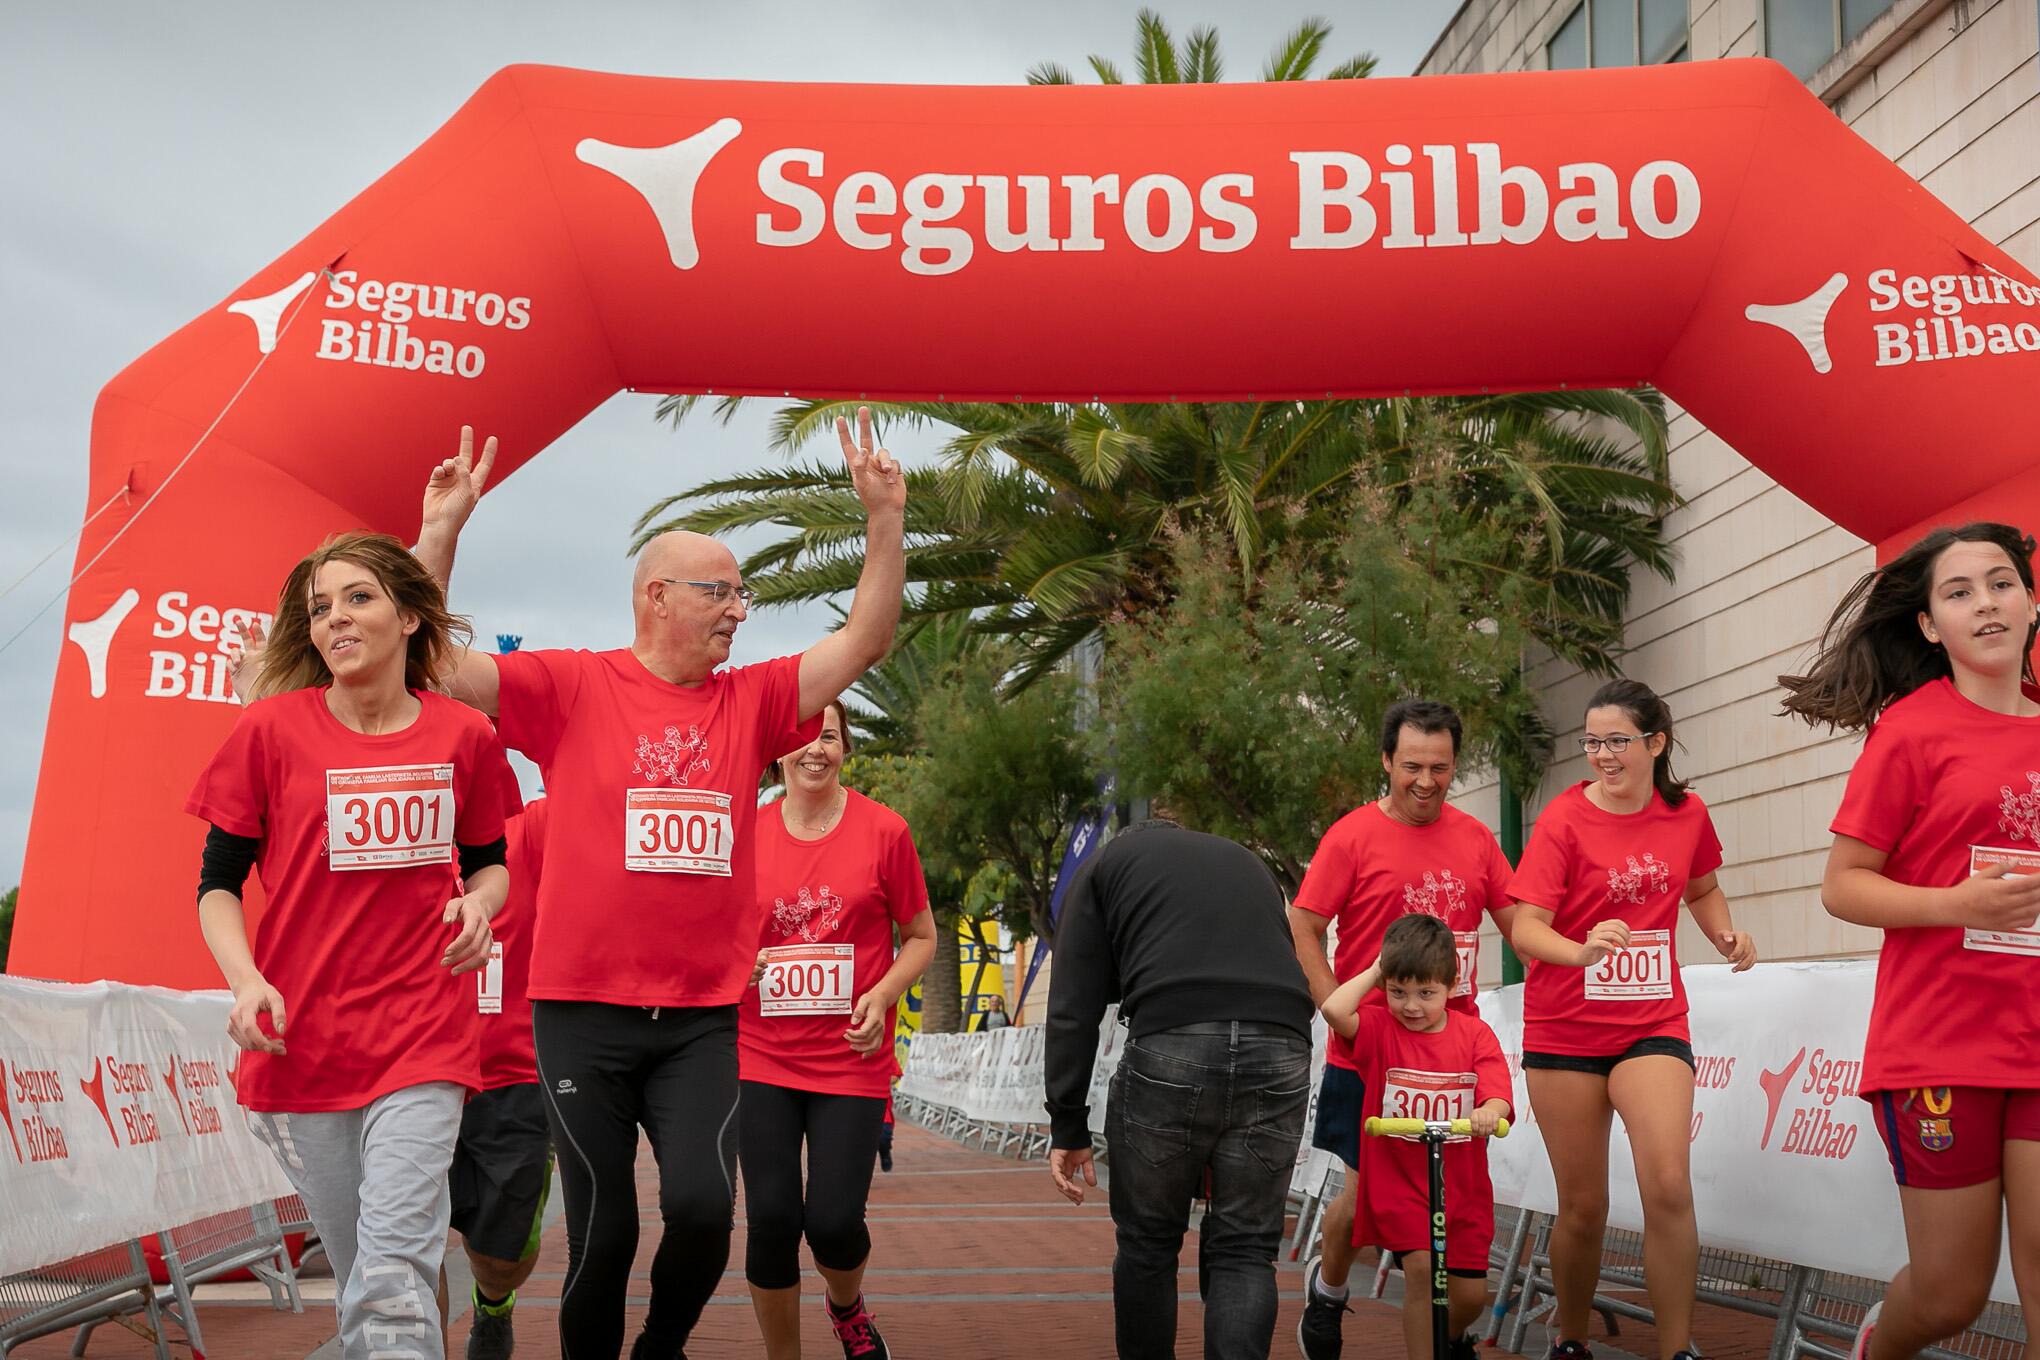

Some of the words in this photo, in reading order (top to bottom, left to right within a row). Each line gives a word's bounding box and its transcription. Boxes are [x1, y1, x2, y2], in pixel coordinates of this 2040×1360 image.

[755, 147, 1256, 276] Seguros
[1289, 142, 1702, 250] Bilbao
[325, 270, 532, 330] Seguros
[315, 319, 486, 379] Bilbao
[1872, 315, 2040, 367] Bilbao
[144, 650, 243, 706] Bil
[344, 794, 440, 847] 3001
[639, 813, 722, 855] 3001
[769, 963, 840, 998] 3001
[1596, 949, 1662, 983] 3001
[11, 1059, 64, 1113] Seguros
[1801, 1048, 1861, 1106] Segu
[188, 1098, 222, 1136] Bilbao
[1392, 1089, 1463, 1122] 3001
[22, 1115, 68, 1162] Bilbao
[1780, 1106, 1858, 1160] Bilbao
